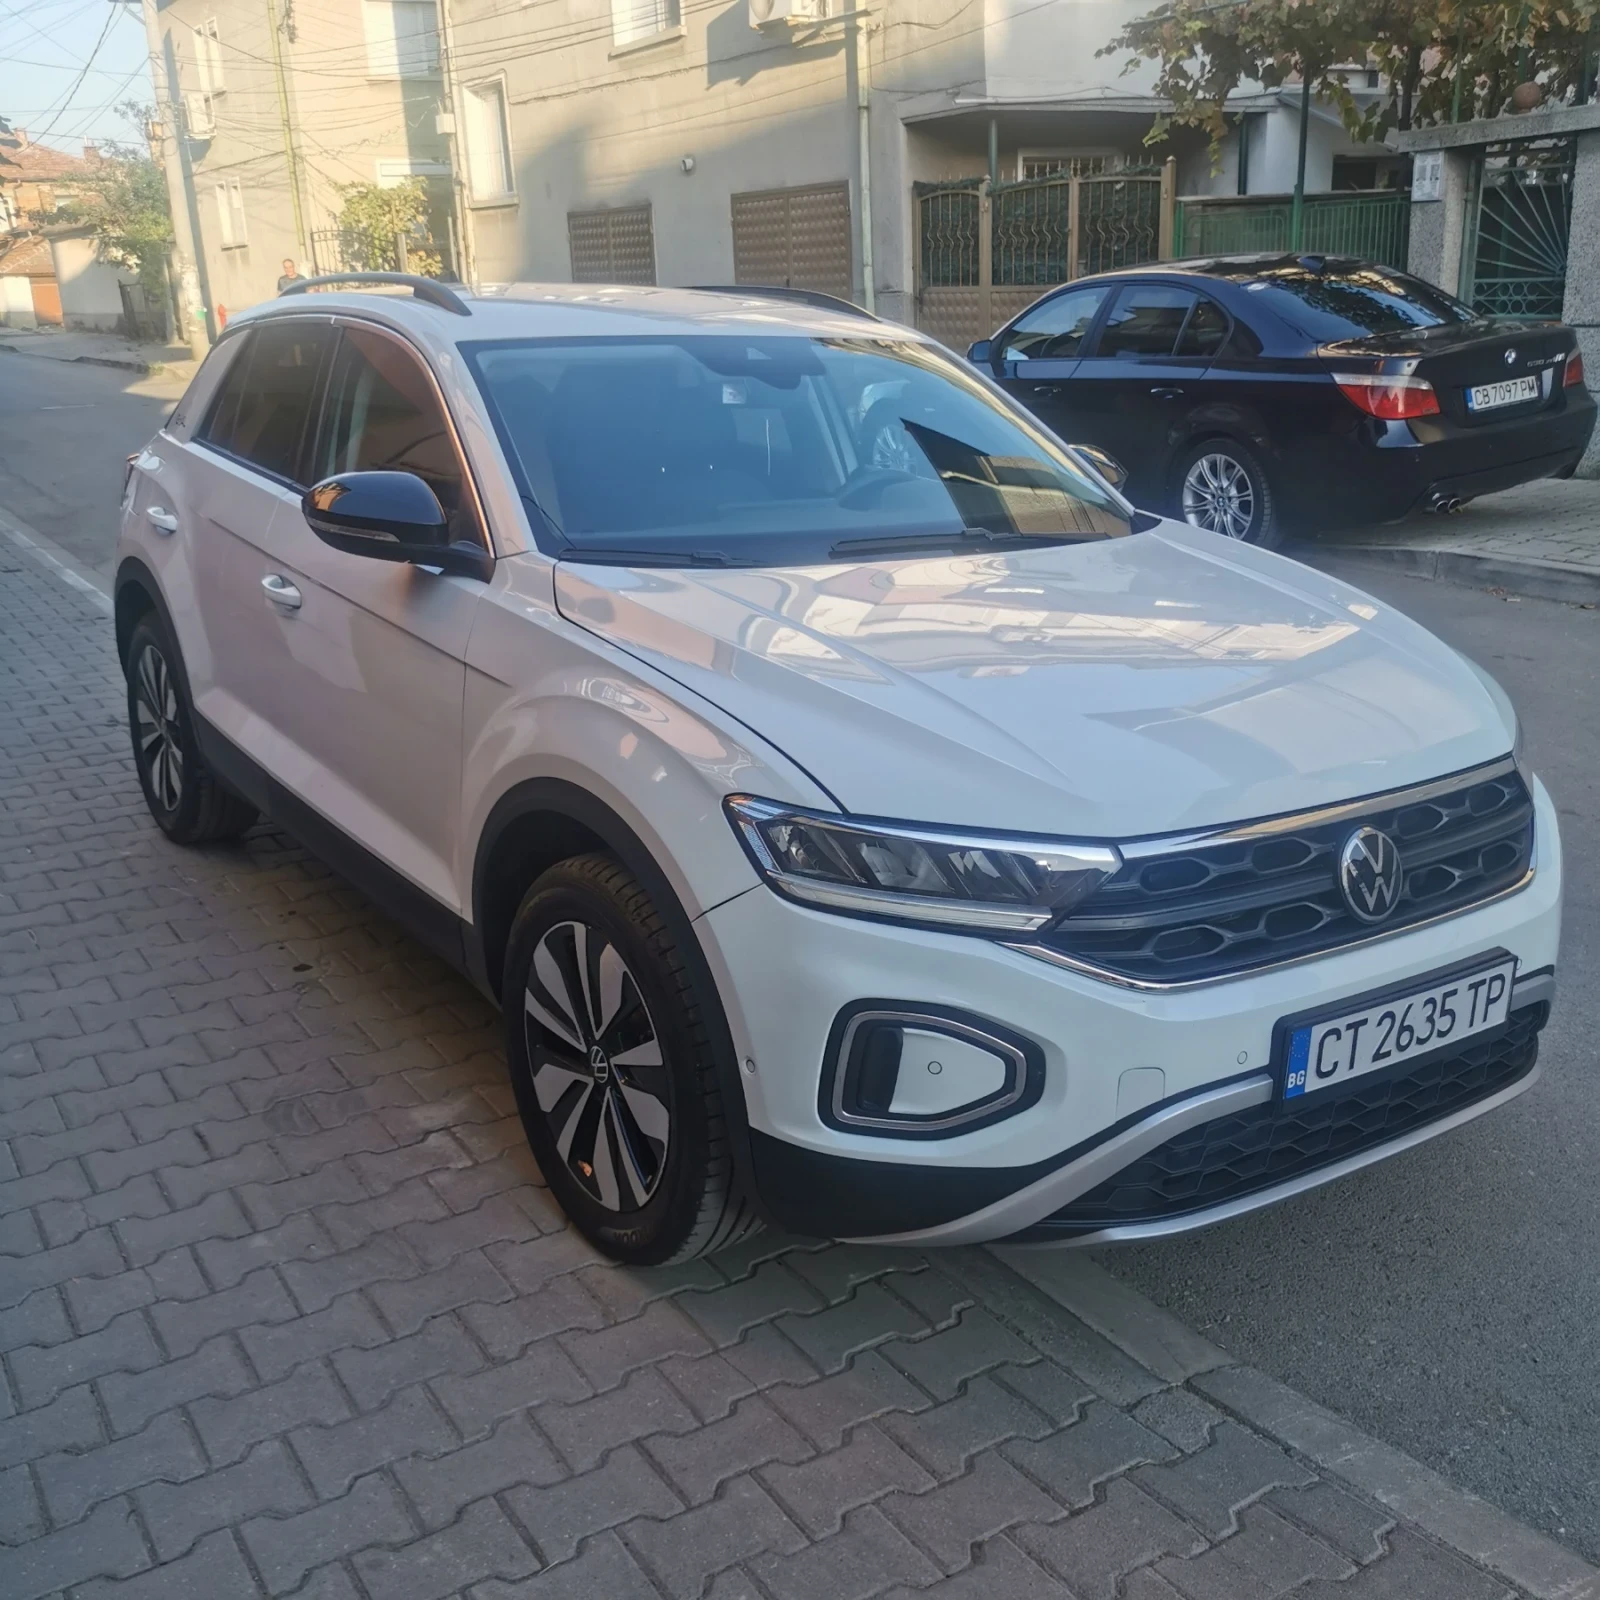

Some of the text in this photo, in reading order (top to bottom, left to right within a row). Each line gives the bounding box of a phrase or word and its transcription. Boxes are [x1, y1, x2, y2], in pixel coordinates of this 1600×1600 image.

[1474, 379, 1536, 406] CB 7097 PM
[1316, 973, 1506, 1078] CT 2635 TP
[1287, 1069, 1305, 1089] BG
